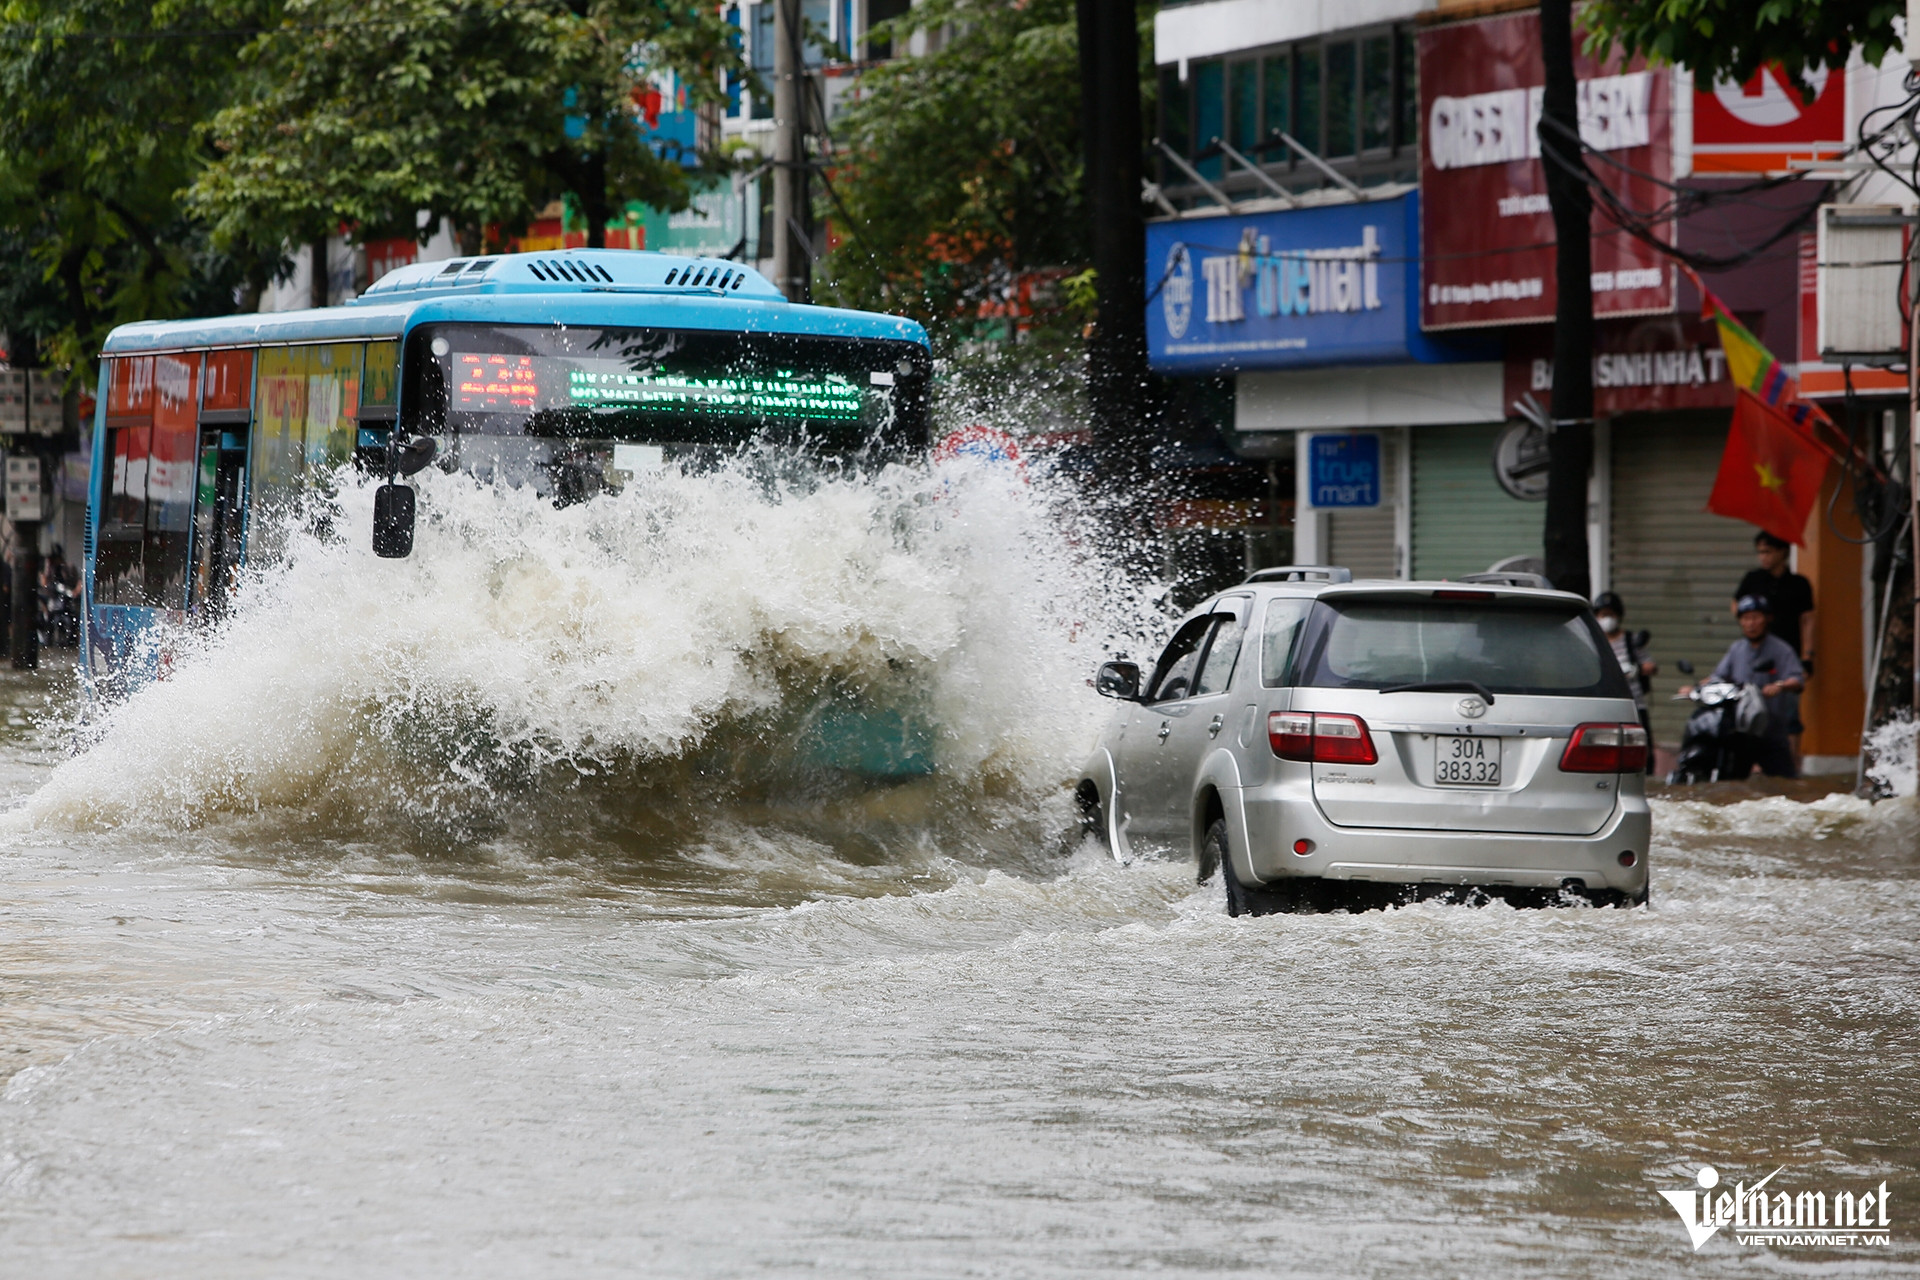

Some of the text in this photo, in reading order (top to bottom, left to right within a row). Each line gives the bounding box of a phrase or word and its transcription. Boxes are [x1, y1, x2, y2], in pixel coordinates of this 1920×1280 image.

[1598, 352, 1651, 387] SINH
[1317, 459, 1373, 483] true
[1317, 483, 1373, 503] mart
[1452, 739, 1485, 760] 30A
[1438, 761, 1498, 782] 383.32
